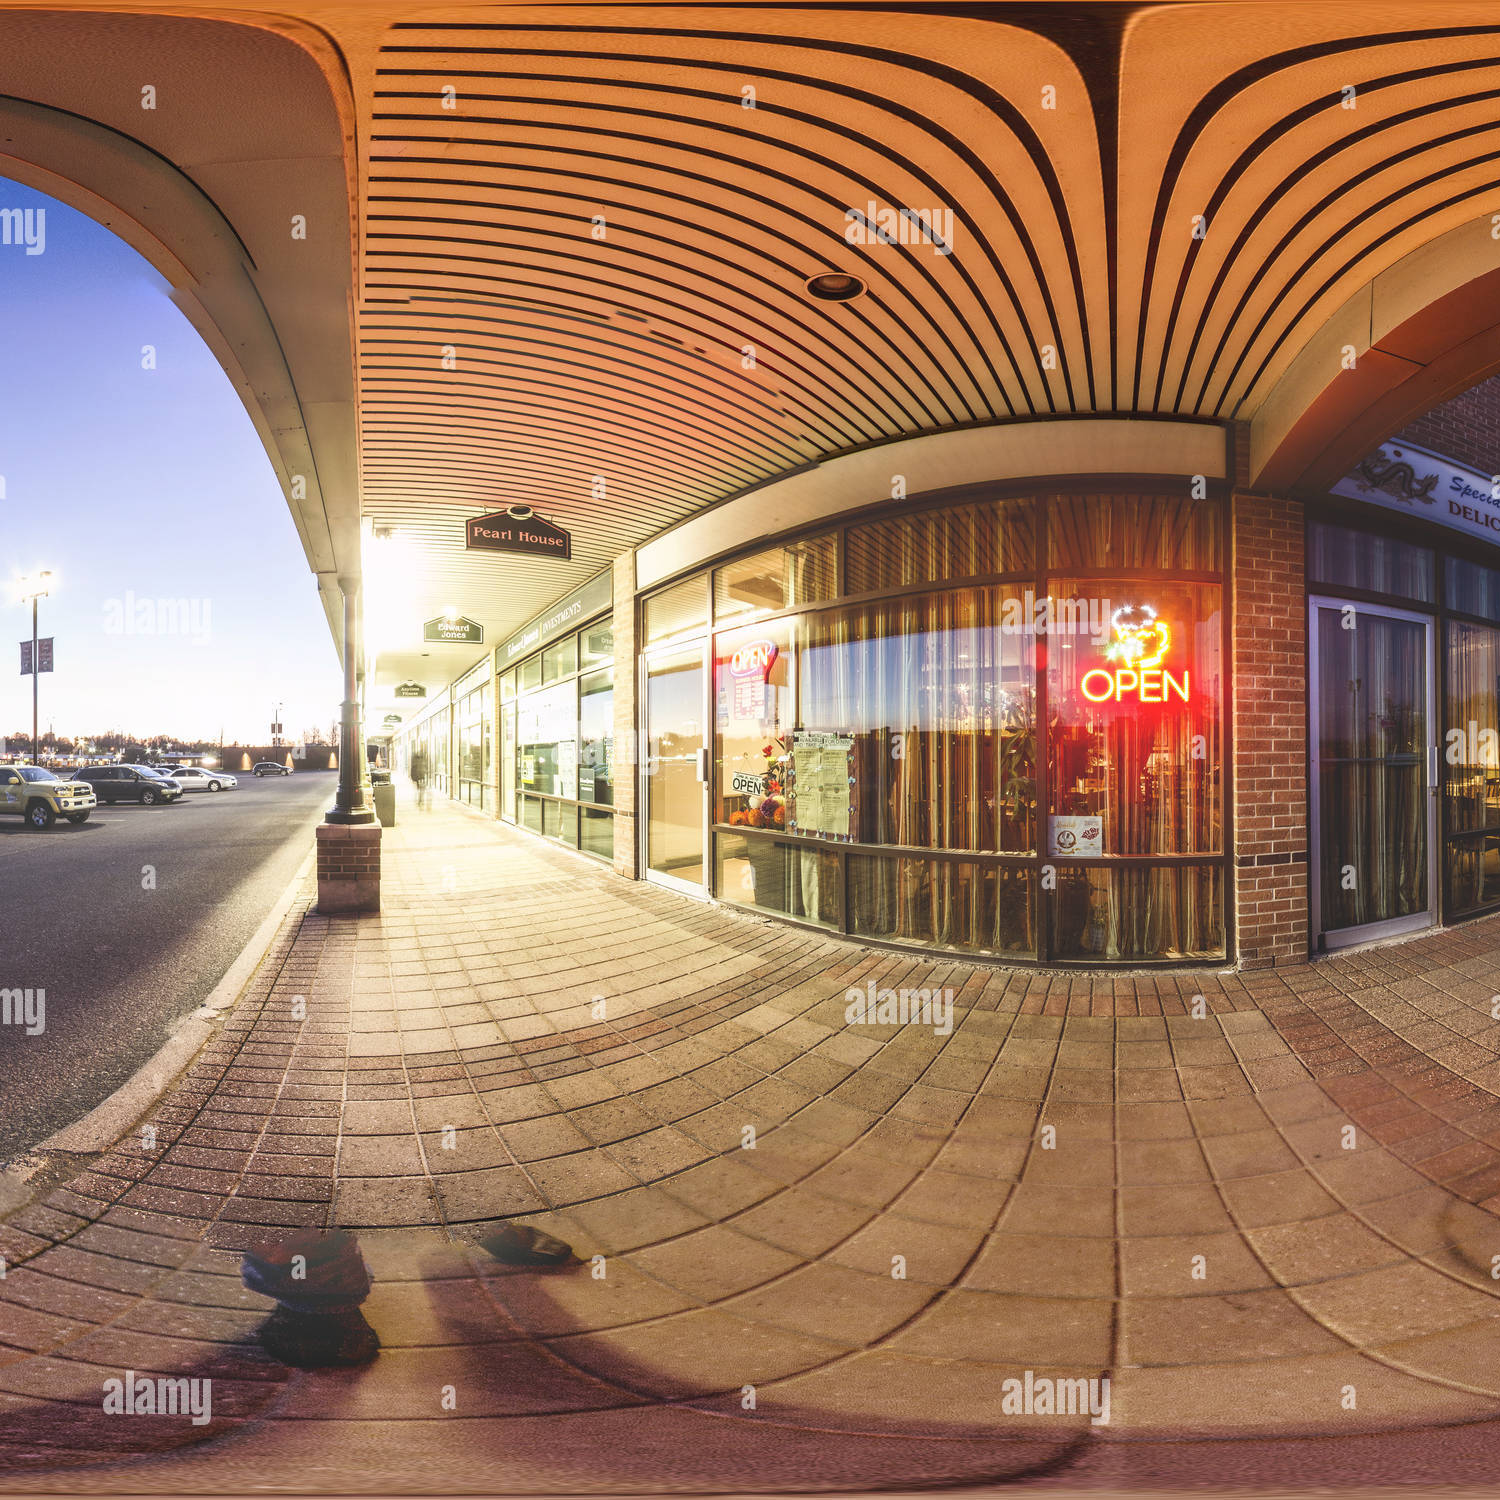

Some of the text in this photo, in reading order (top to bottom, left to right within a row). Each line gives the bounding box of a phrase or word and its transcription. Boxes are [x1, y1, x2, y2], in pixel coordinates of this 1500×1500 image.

[473, 526, 564, 547] Pearl House
[438, 623, 470, 633] Edward
[441, 631, 466, 639] Jones
[731, 646, 768, 672] OPEN
[1081, 669, 1189, 702] OPEN
[732, 777, 762, 795] OPEN
